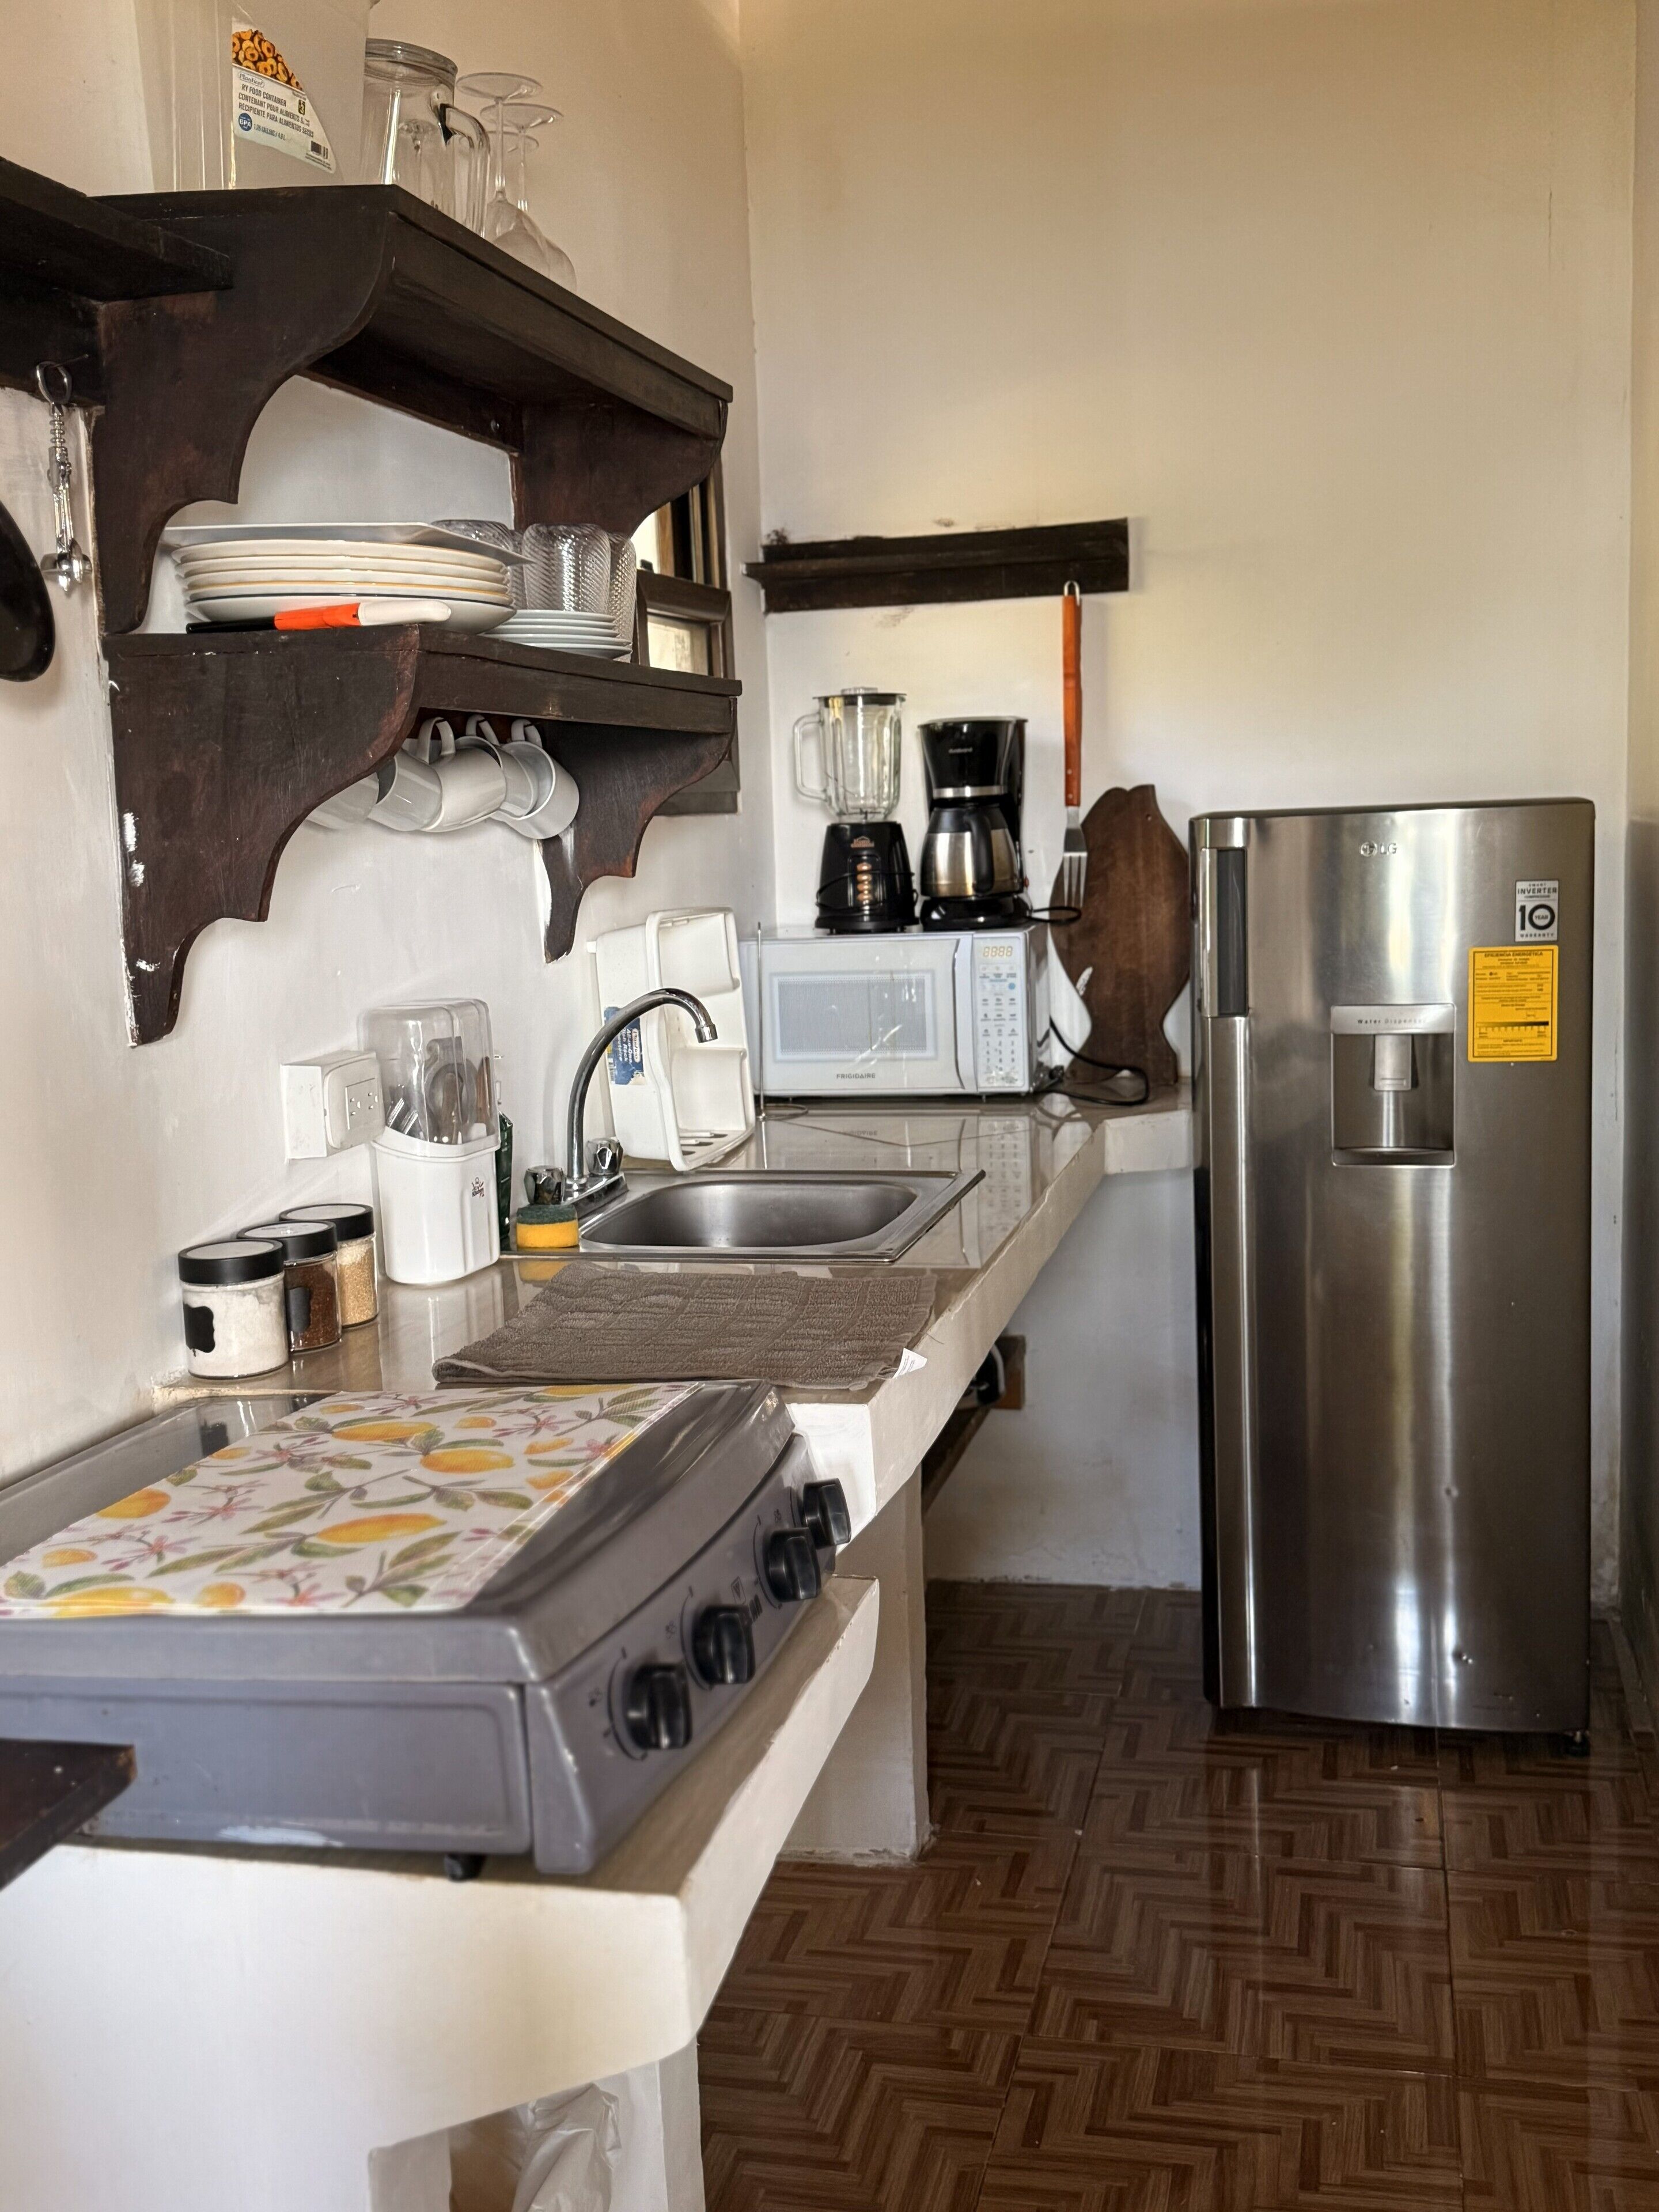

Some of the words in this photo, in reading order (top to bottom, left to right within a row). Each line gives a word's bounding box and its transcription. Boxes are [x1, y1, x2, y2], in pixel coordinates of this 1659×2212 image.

[238, 93, 266, 108] CONTENANT
[267, 103, 279, 112] POUR
[249, 86, 262, 97] FOOD
[263, 92, 286, 107] CONTAINER
[239, 119, 251, 127] BPA
[267, 112, 278, 122] PARA
[1380, 843, 1397, 854] LG
[1519, 904, 1555, 930] 10
